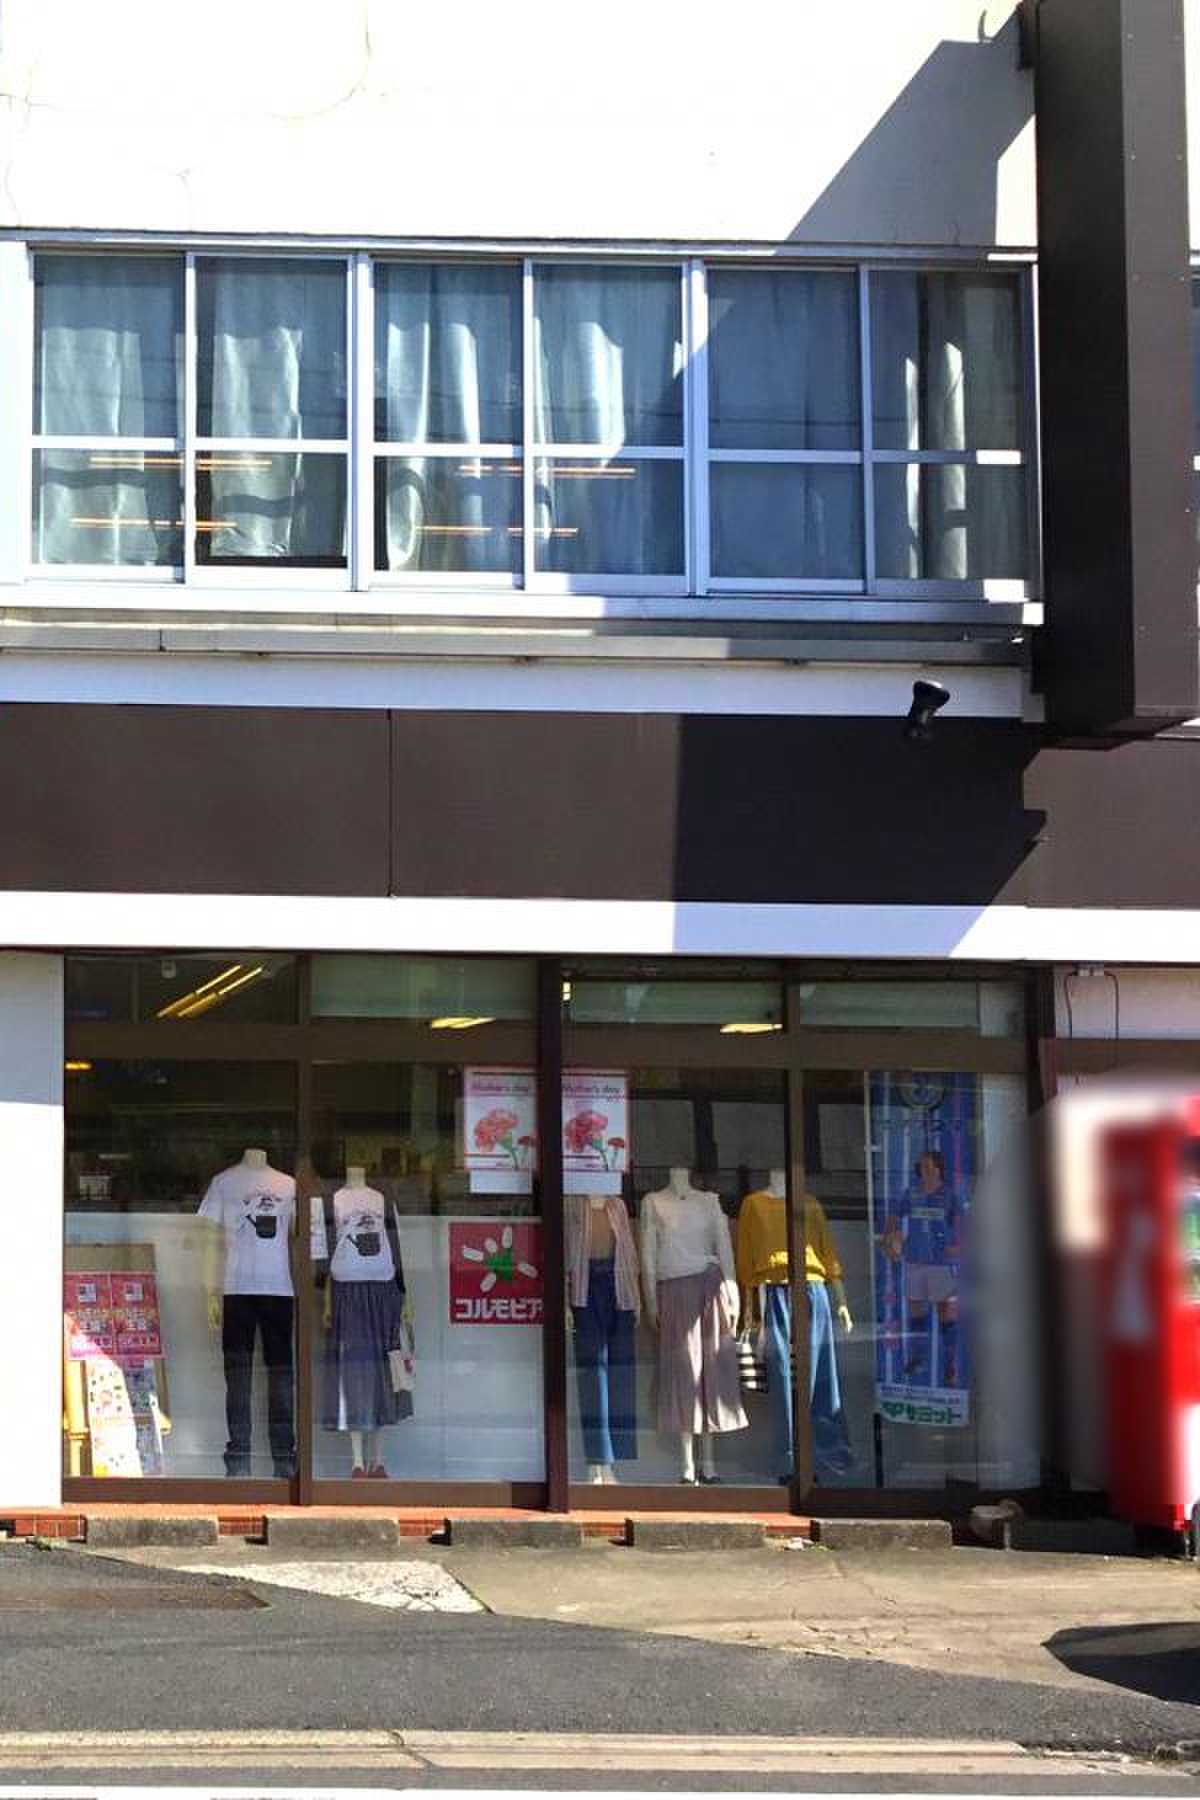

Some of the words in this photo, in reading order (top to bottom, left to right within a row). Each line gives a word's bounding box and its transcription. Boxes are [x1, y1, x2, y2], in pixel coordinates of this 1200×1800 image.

[455, 1298, 544, 1319] コルモピア
